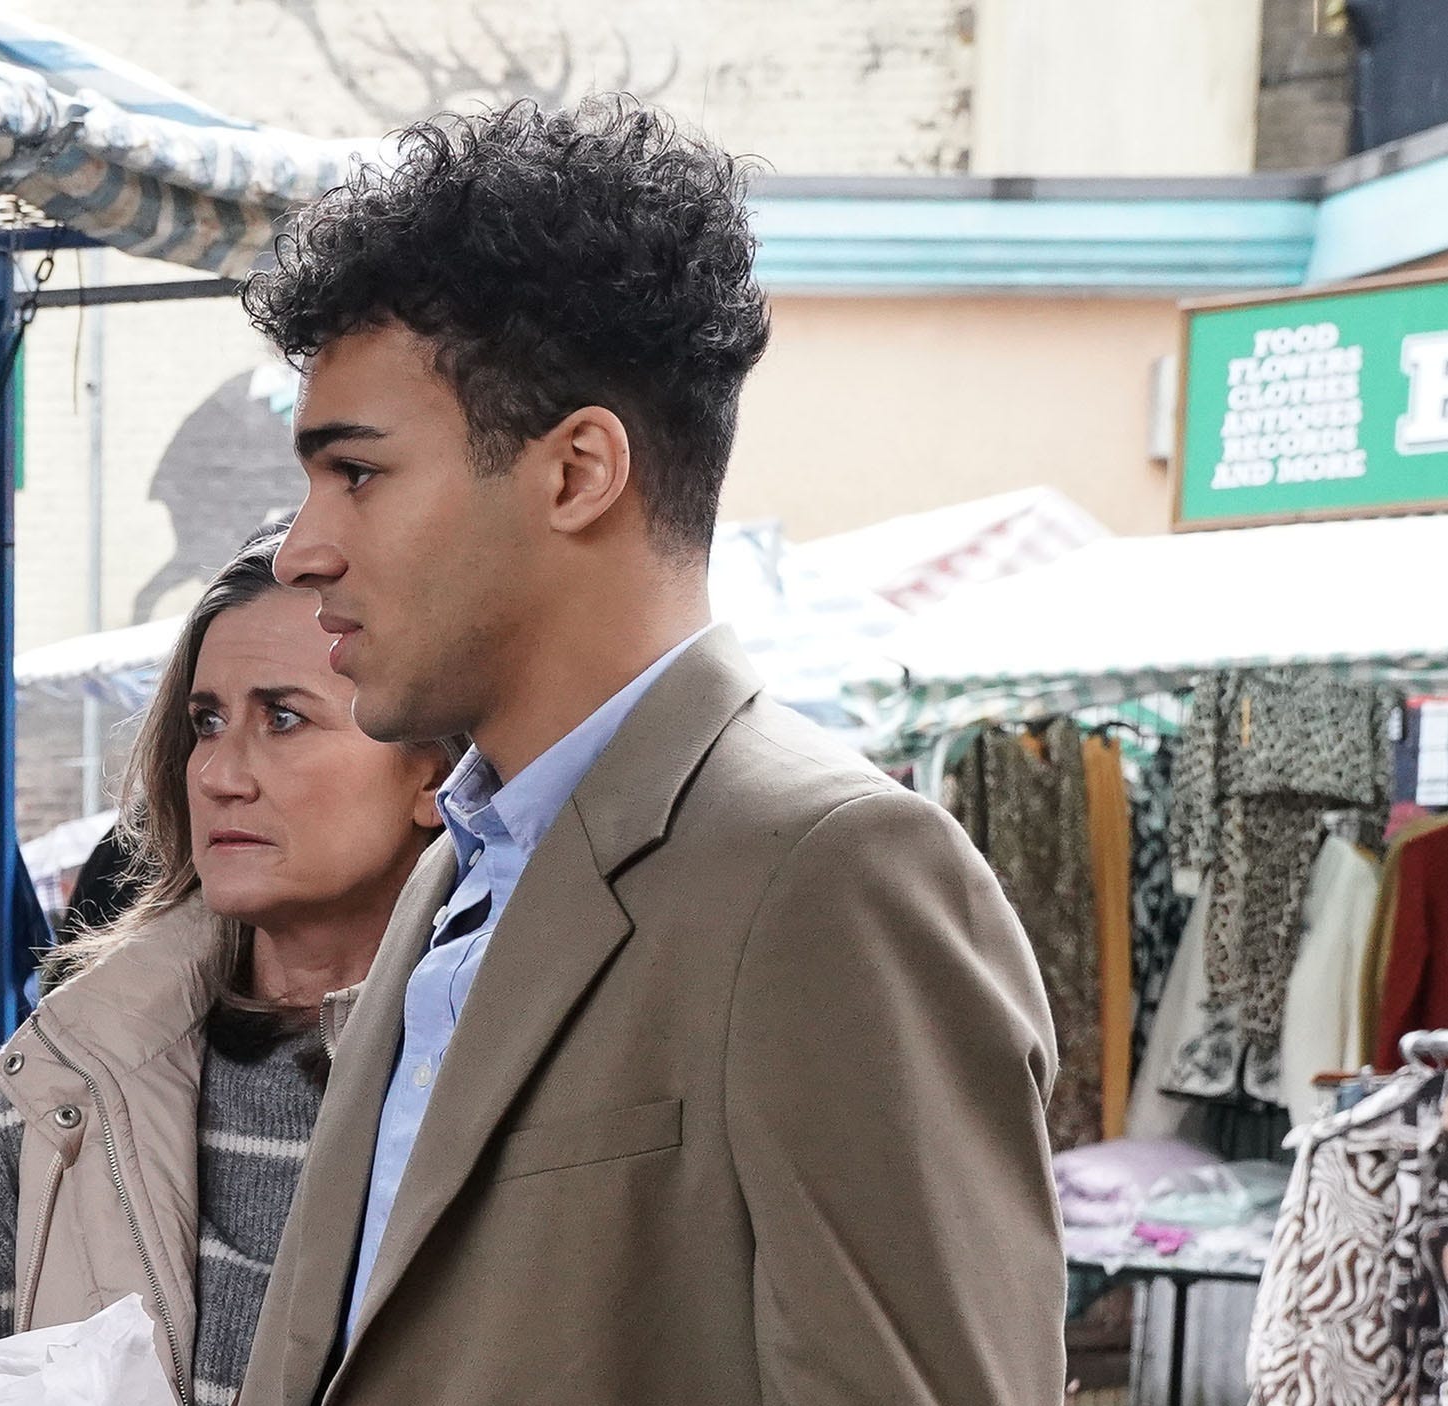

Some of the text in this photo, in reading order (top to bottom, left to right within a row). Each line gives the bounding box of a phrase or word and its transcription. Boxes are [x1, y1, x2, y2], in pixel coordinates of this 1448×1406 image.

[1253, 322, 1340, 357] FOOD
[1227, 374, 1360, 411] CLOTHES
[1222, 426, 1358, 461] RECORDS
[1211, 448, 1367, 489] AND MORE
